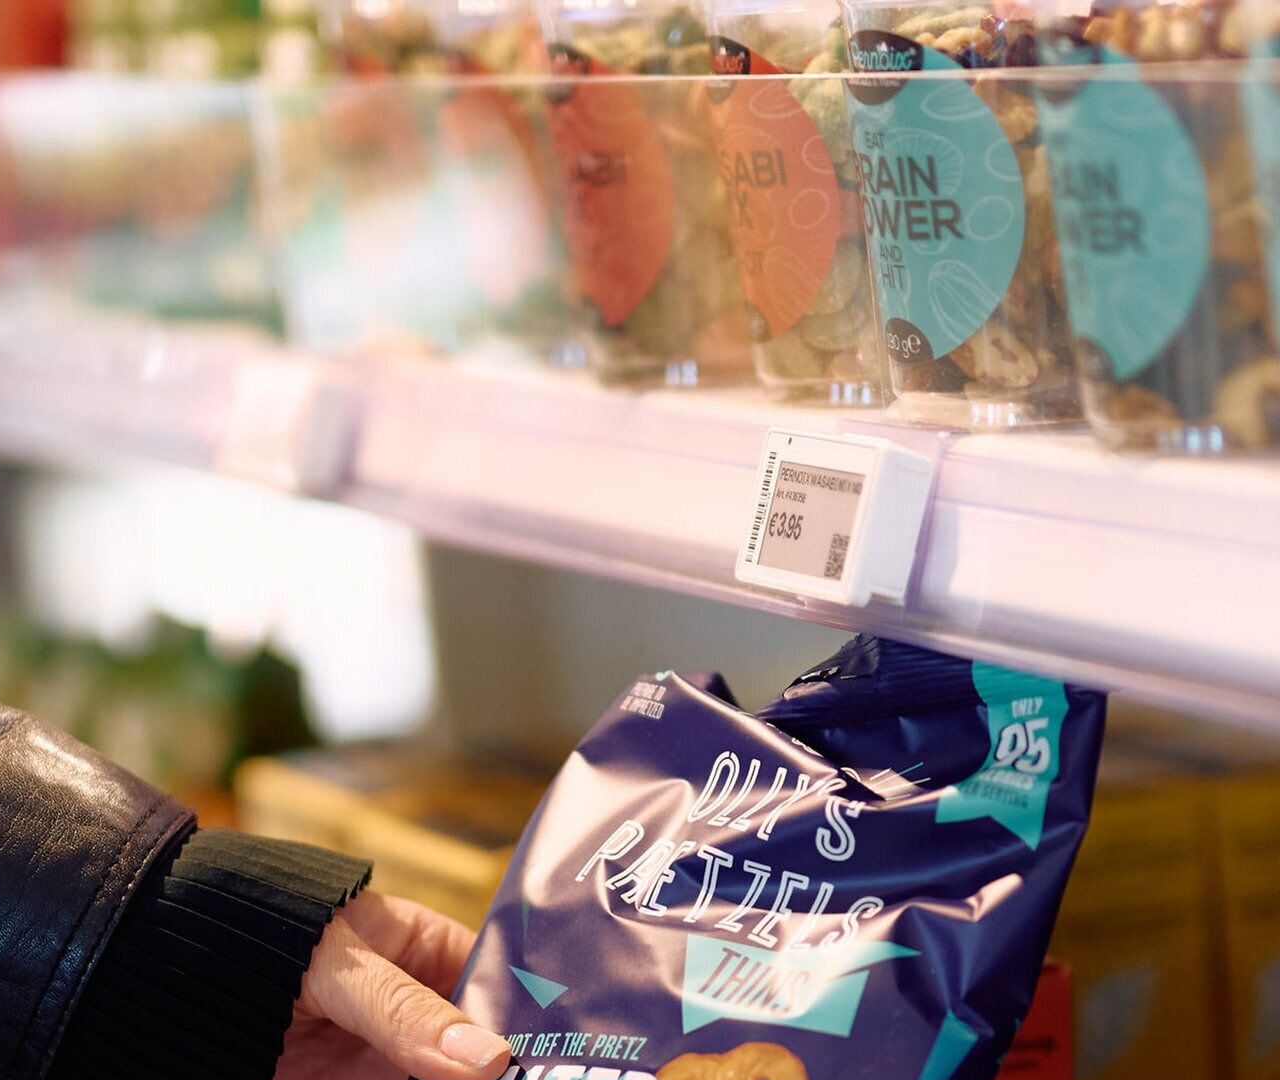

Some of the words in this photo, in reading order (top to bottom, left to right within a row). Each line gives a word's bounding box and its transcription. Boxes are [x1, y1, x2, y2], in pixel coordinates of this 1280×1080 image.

[864, 131, 885, 150] EAT
[862, 195, 965, 241] OWER
[879, 243, 903, 263] AND
[880, 262, 905, 290] HIT
[1011, 697, 1043, 718] ONLY
[575, 819, 885, 952] PRETZELS
[698, 946, 811, 1014] THINS
[531, 1032, 562, 1057] OFF
[560, 1032, 592, 1057] THE
[589, 1033, 648, 1061] PRETZ
